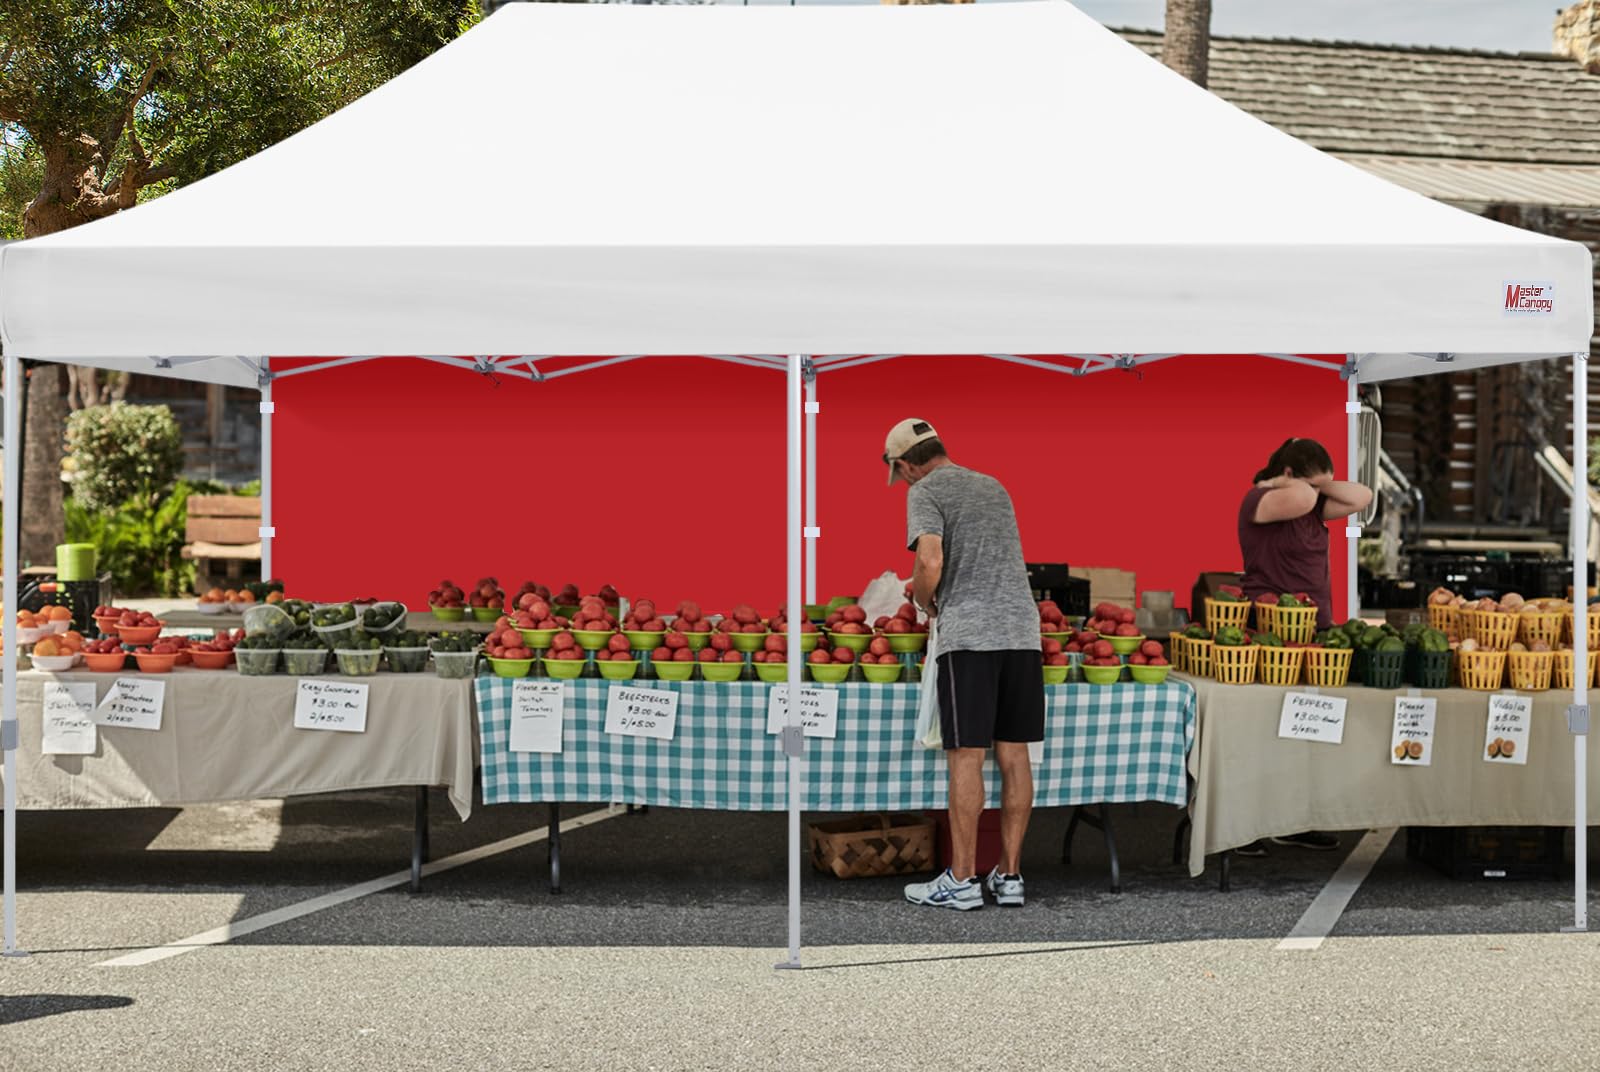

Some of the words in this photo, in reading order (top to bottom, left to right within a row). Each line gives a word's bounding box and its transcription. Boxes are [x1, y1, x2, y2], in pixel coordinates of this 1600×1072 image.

[1505, 285, 1544, 308] Master
[1519, 297, 1553, 312] Canopy
[1292, 696, 1333, 710] PEPPERS
[1493, 699, 1526, 712] Vidalia
